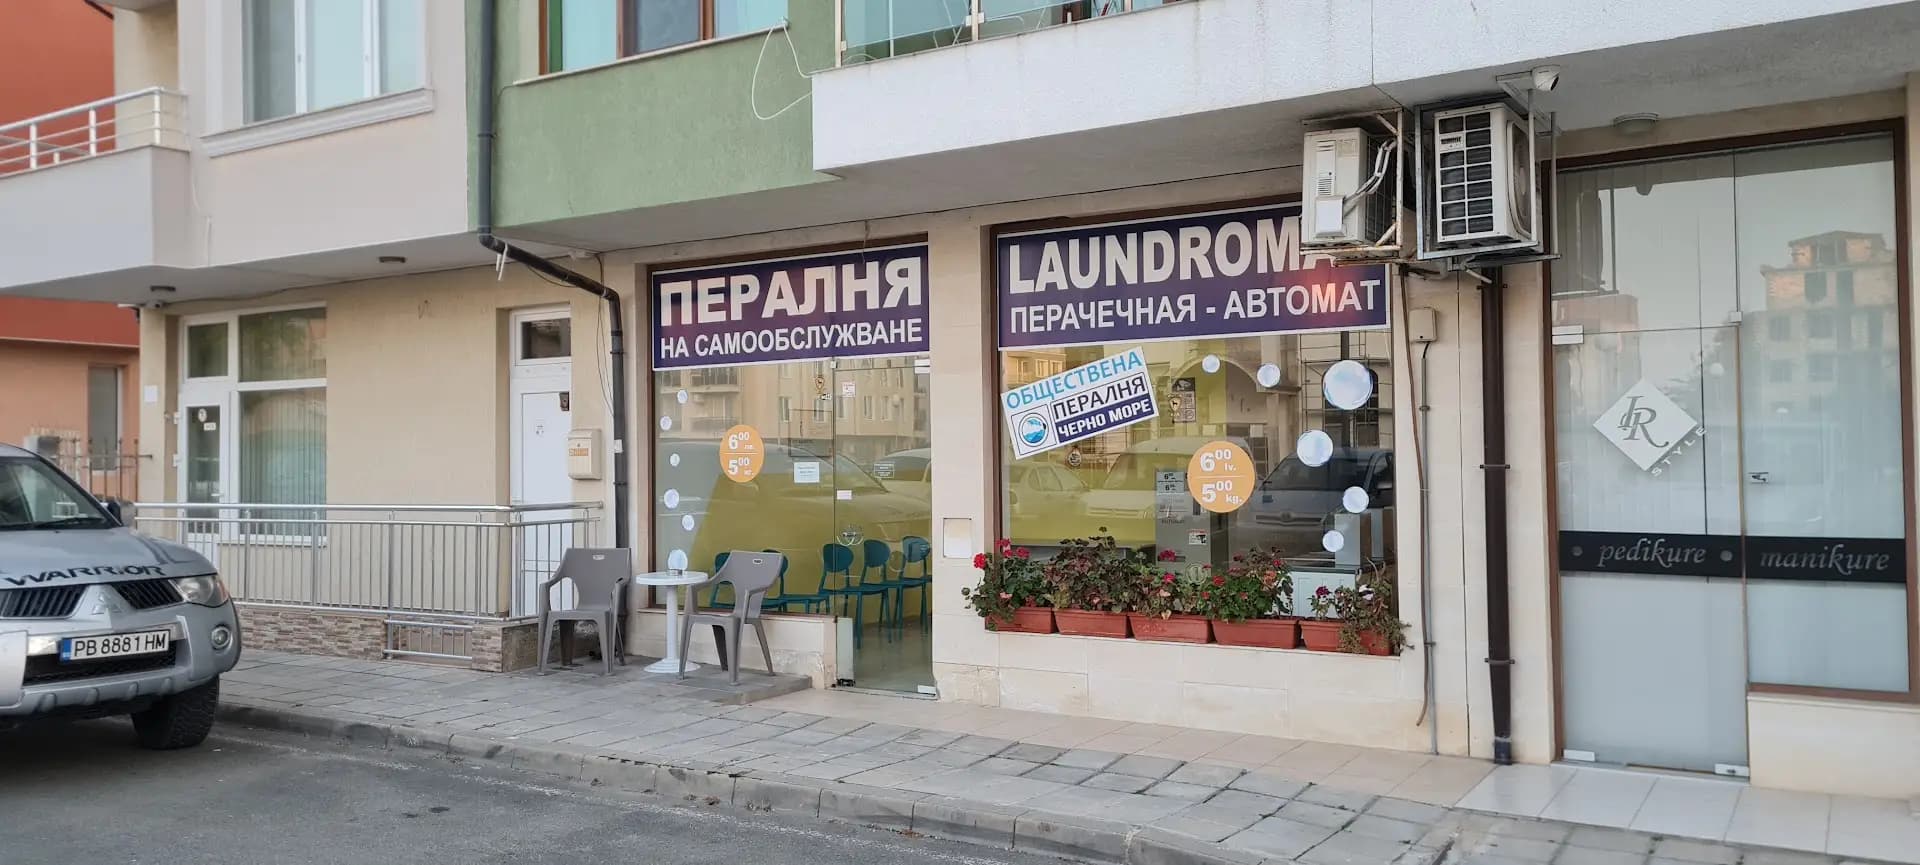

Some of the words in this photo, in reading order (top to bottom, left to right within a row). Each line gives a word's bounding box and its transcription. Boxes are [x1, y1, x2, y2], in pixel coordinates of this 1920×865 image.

[1009, 215, 1335, 294] LAUNDROM
[660, 256, 921, 327] ПЕРАЛНЯ
[1010, 293, 1196, 334] ПЕРАЧЕЧНАЯ
[1223, 280, 1381, 320] АВТОМАТ
[660, 336, 690, 359] НА
[694, 318, 922, 357] САМООБСЛУЖВАНЕ
[1006, 351, 1143, 409] ОБЩЕСТВЕНА
[1053, 376, 1147, 420] ПЕРАЛНЯ
[1058, 415, 1107, 437] ЧЕРНО
[1109, 398, 1152, 423] МОРЕ
[1651, 425, 1707, 477] STYLE
[6, 565, 167, 586] WARRIOR
[1597, 538, 1707, 568] pedikure
[1760, 543, 1890, 575] manikure
[74, 640, 97, 656] PB
[100, 633, 141, 655] 8881
[145, 633, 167, 650] HM
